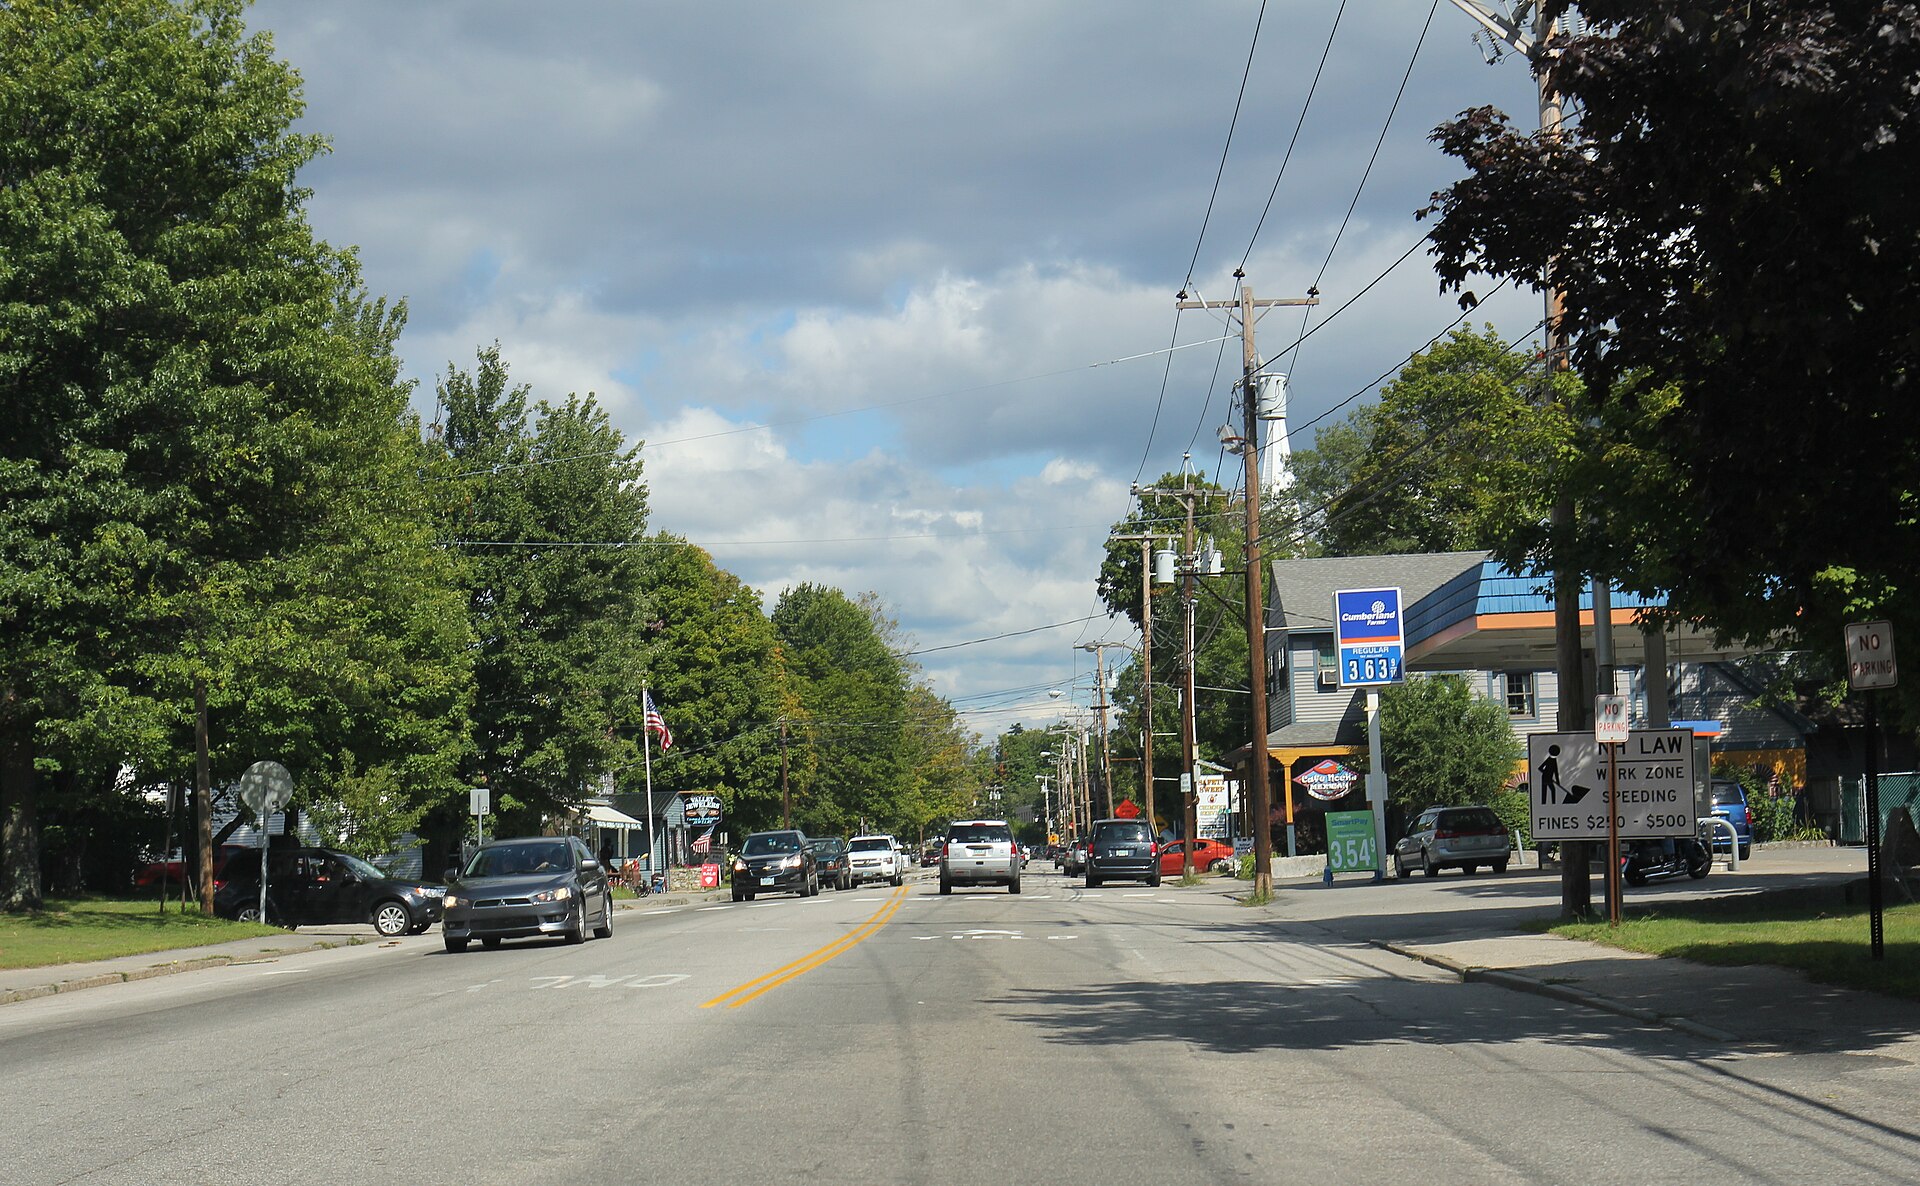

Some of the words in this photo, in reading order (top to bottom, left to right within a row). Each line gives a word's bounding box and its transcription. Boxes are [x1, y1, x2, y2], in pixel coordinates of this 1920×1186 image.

[1341, 611, 1396, 622] Cumberland
[1859, 633, 1881, 651] NO
[1352, 646, 1390, 655] REGULAR
[1349, 659, 1388, 681] 3.63
[1852, 659, 1892, 678] PARKING
[1604, 703, 1619, 715] NO
[1598, 722, 1626, 733] PARKING
[1640, 736, 1683, 755] LAW
[1596, 767, 1637, 781] WRK
[1645, 766, 1685, 780] ZONE
[685, 801, 720, 811] JEWELERS
[1538, 816, 1579, 830] FINES
[1646, 813, 1687, 830] $500
